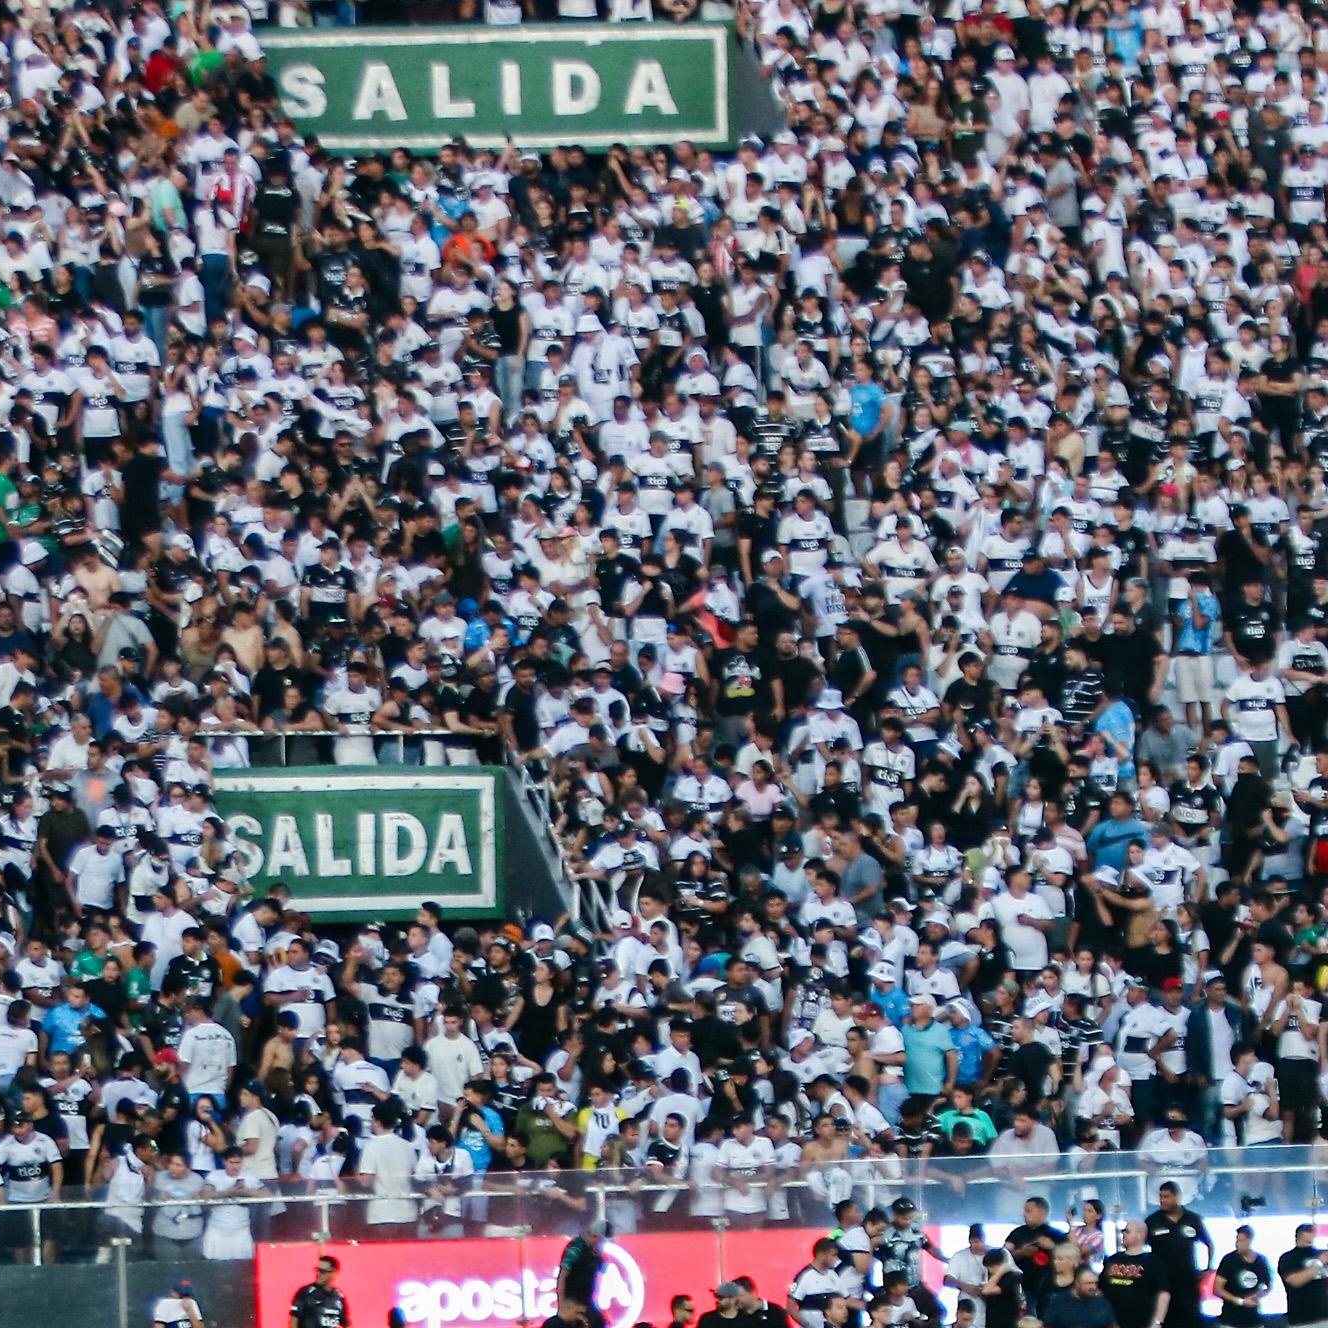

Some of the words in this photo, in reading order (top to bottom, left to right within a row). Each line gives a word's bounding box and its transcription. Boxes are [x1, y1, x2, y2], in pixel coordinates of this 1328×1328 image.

[280, 60, 679, 121] SALIDA
[1248, 700, 1267, 710] tigo
[879, 769, 900, 783] tigo
[227, 812, 472, 879] SALIDA
